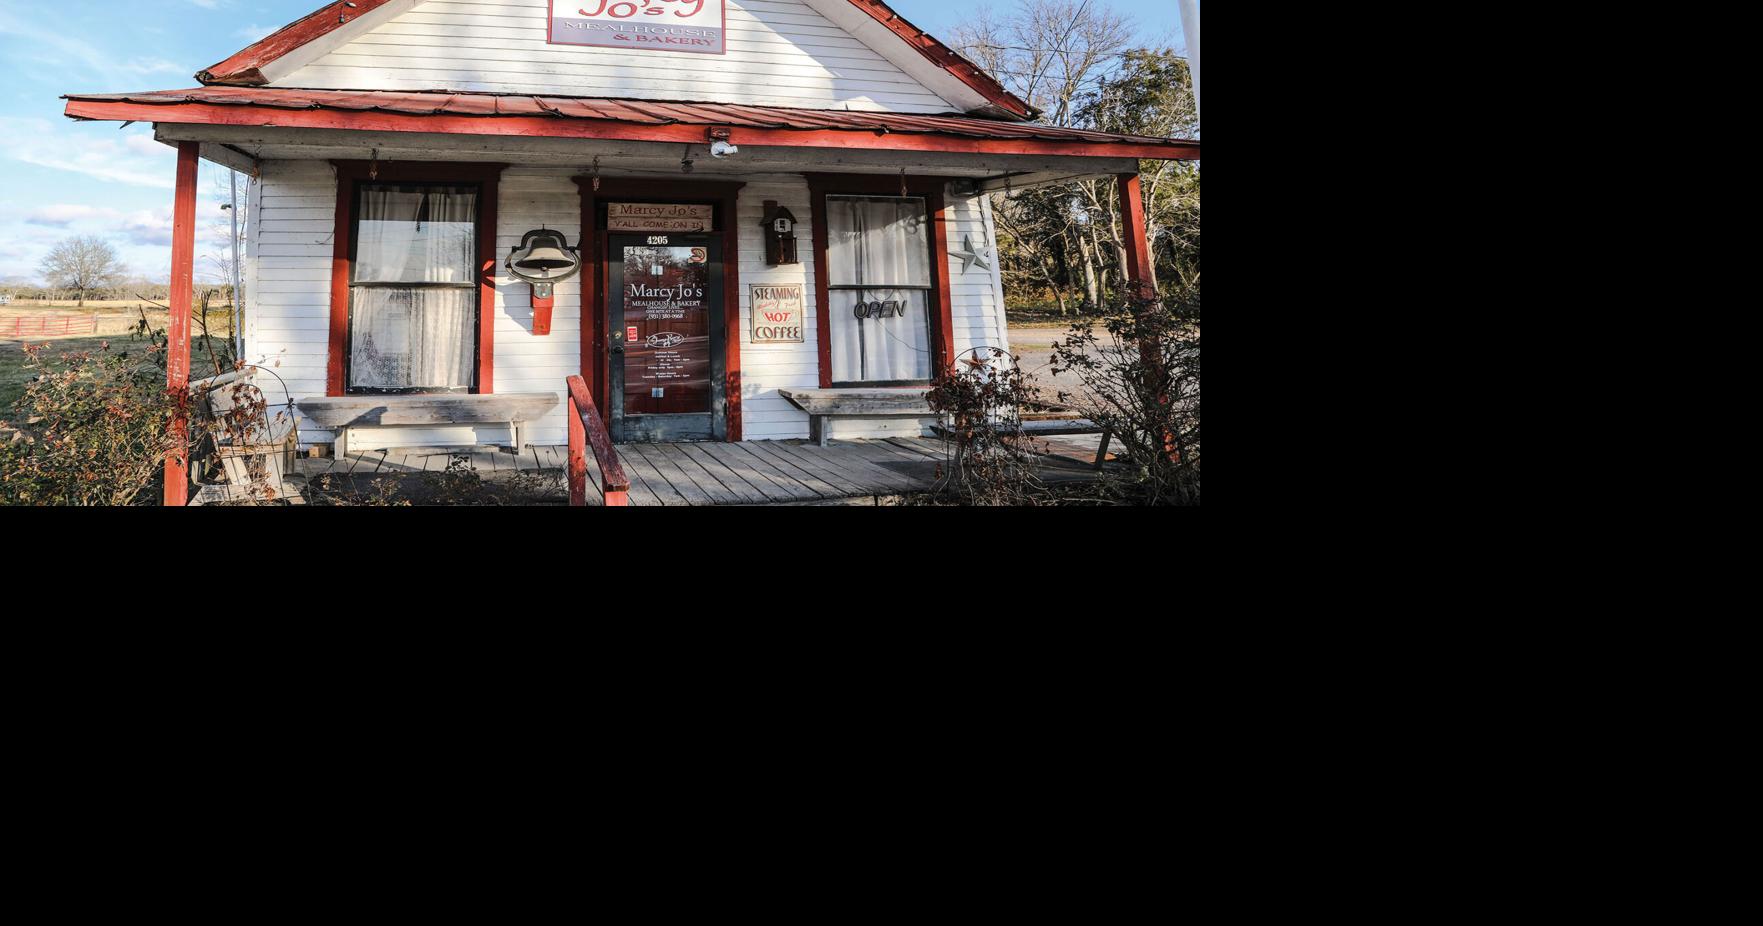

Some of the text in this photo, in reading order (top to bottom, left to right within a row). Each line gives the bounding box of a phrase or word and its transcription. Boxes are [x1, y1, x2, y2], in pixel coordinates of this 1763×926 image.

[564, 21, 716, 38] MEALHOUSE
[613, 33, 716, 46] & BAKERY
[620, 204, 697, 217] Marcy Jo's
[643, 221, 668, 229] COME
[672, 221, 688, 229] ON
[646, 235, 668, 245] 4205
[630, 283, 703, 302] Marcy Jo's
[754, 287, 799, 300] STEAMING
[853, 300, 907, 319] OPEN
[764, 312, 791, 322] HOT
[755, 326, 801, 338] COFFEE
